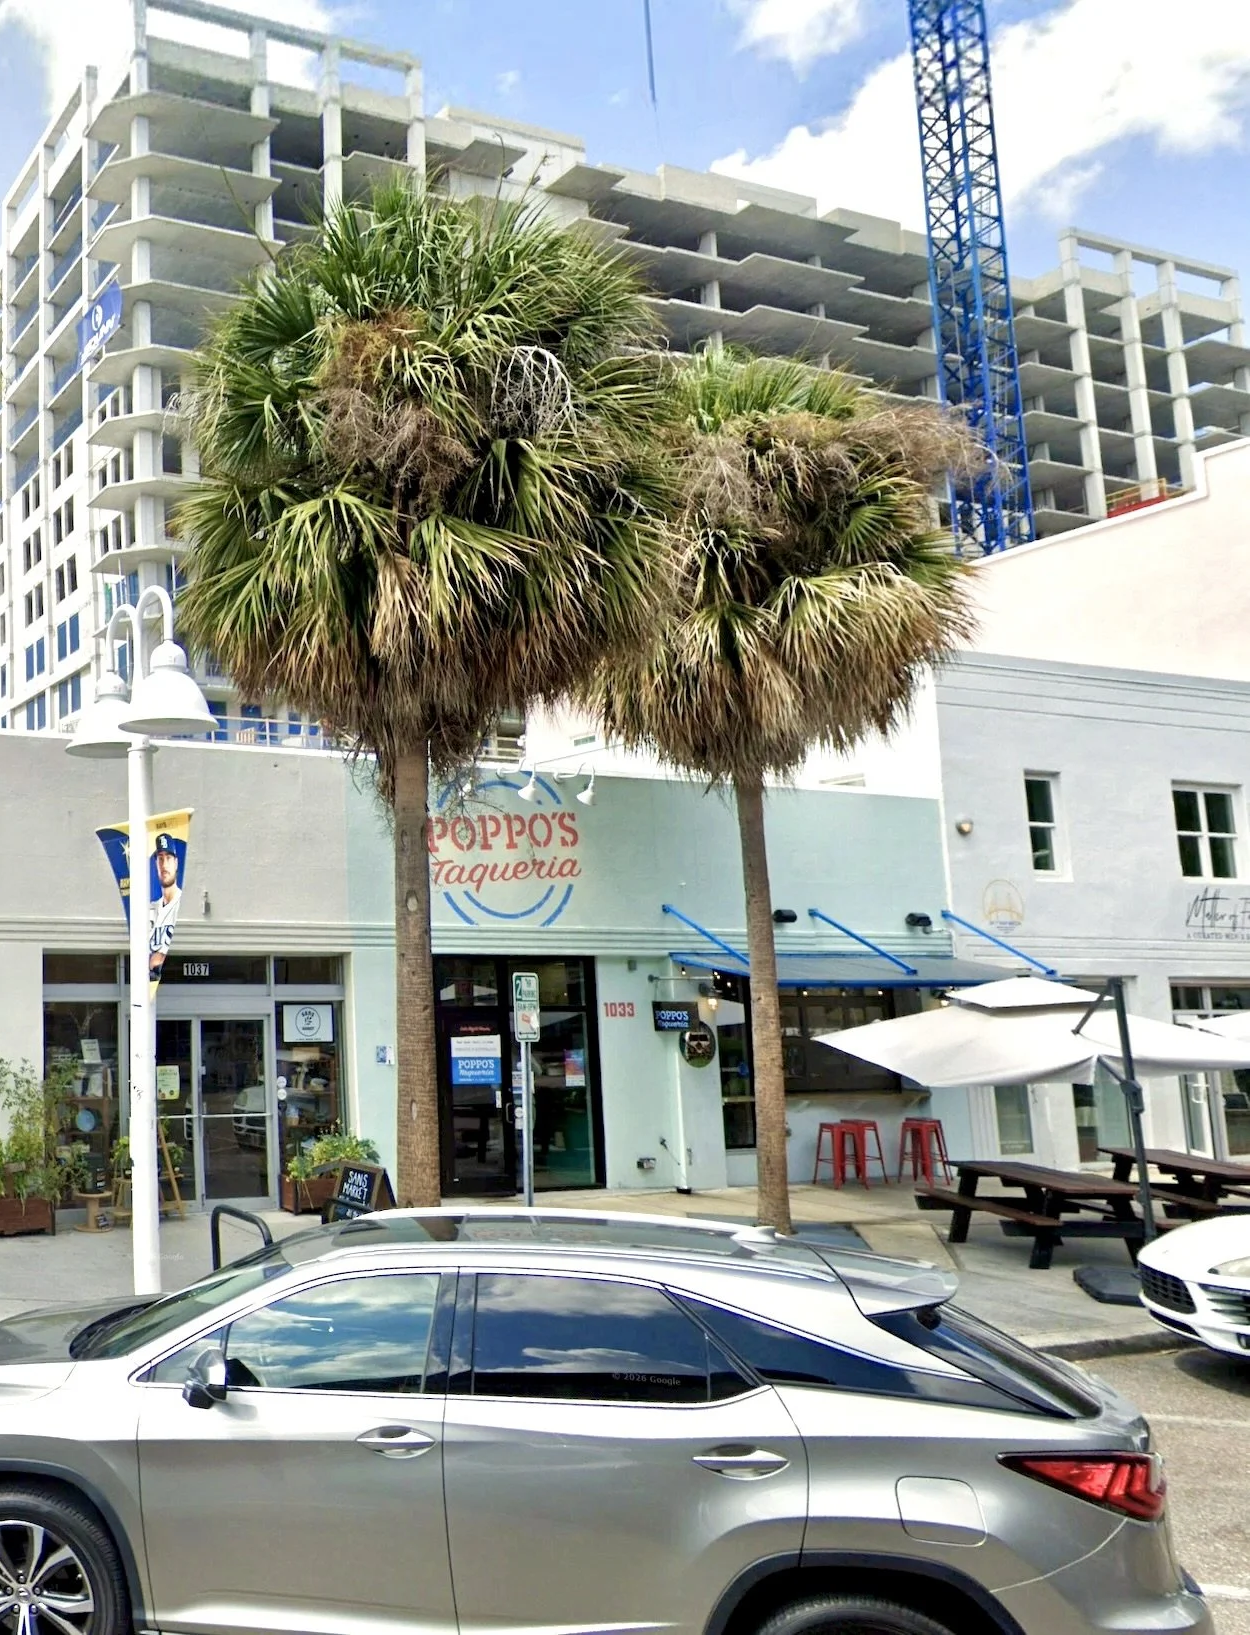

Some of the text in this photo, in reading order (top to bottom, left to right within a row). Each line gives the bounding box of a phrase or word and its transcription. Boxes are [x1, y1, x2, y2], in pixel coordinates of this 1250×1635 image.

[425, 811, 579, 853] POPPO'S
[431, 856, 582, 893] Taqueria
[183, 963, 209, 976] 1037
[515, 979, 523, 1000] 2
[604, 1002, 635, 1018] 1033
[655, 1010, 689, 1021] POPPO'S
[458, 1059, 495, 1070] POPPO'S
[347, 1170, 369, 1188] SANS
[342, 1182, 368, 1206] MARKET
